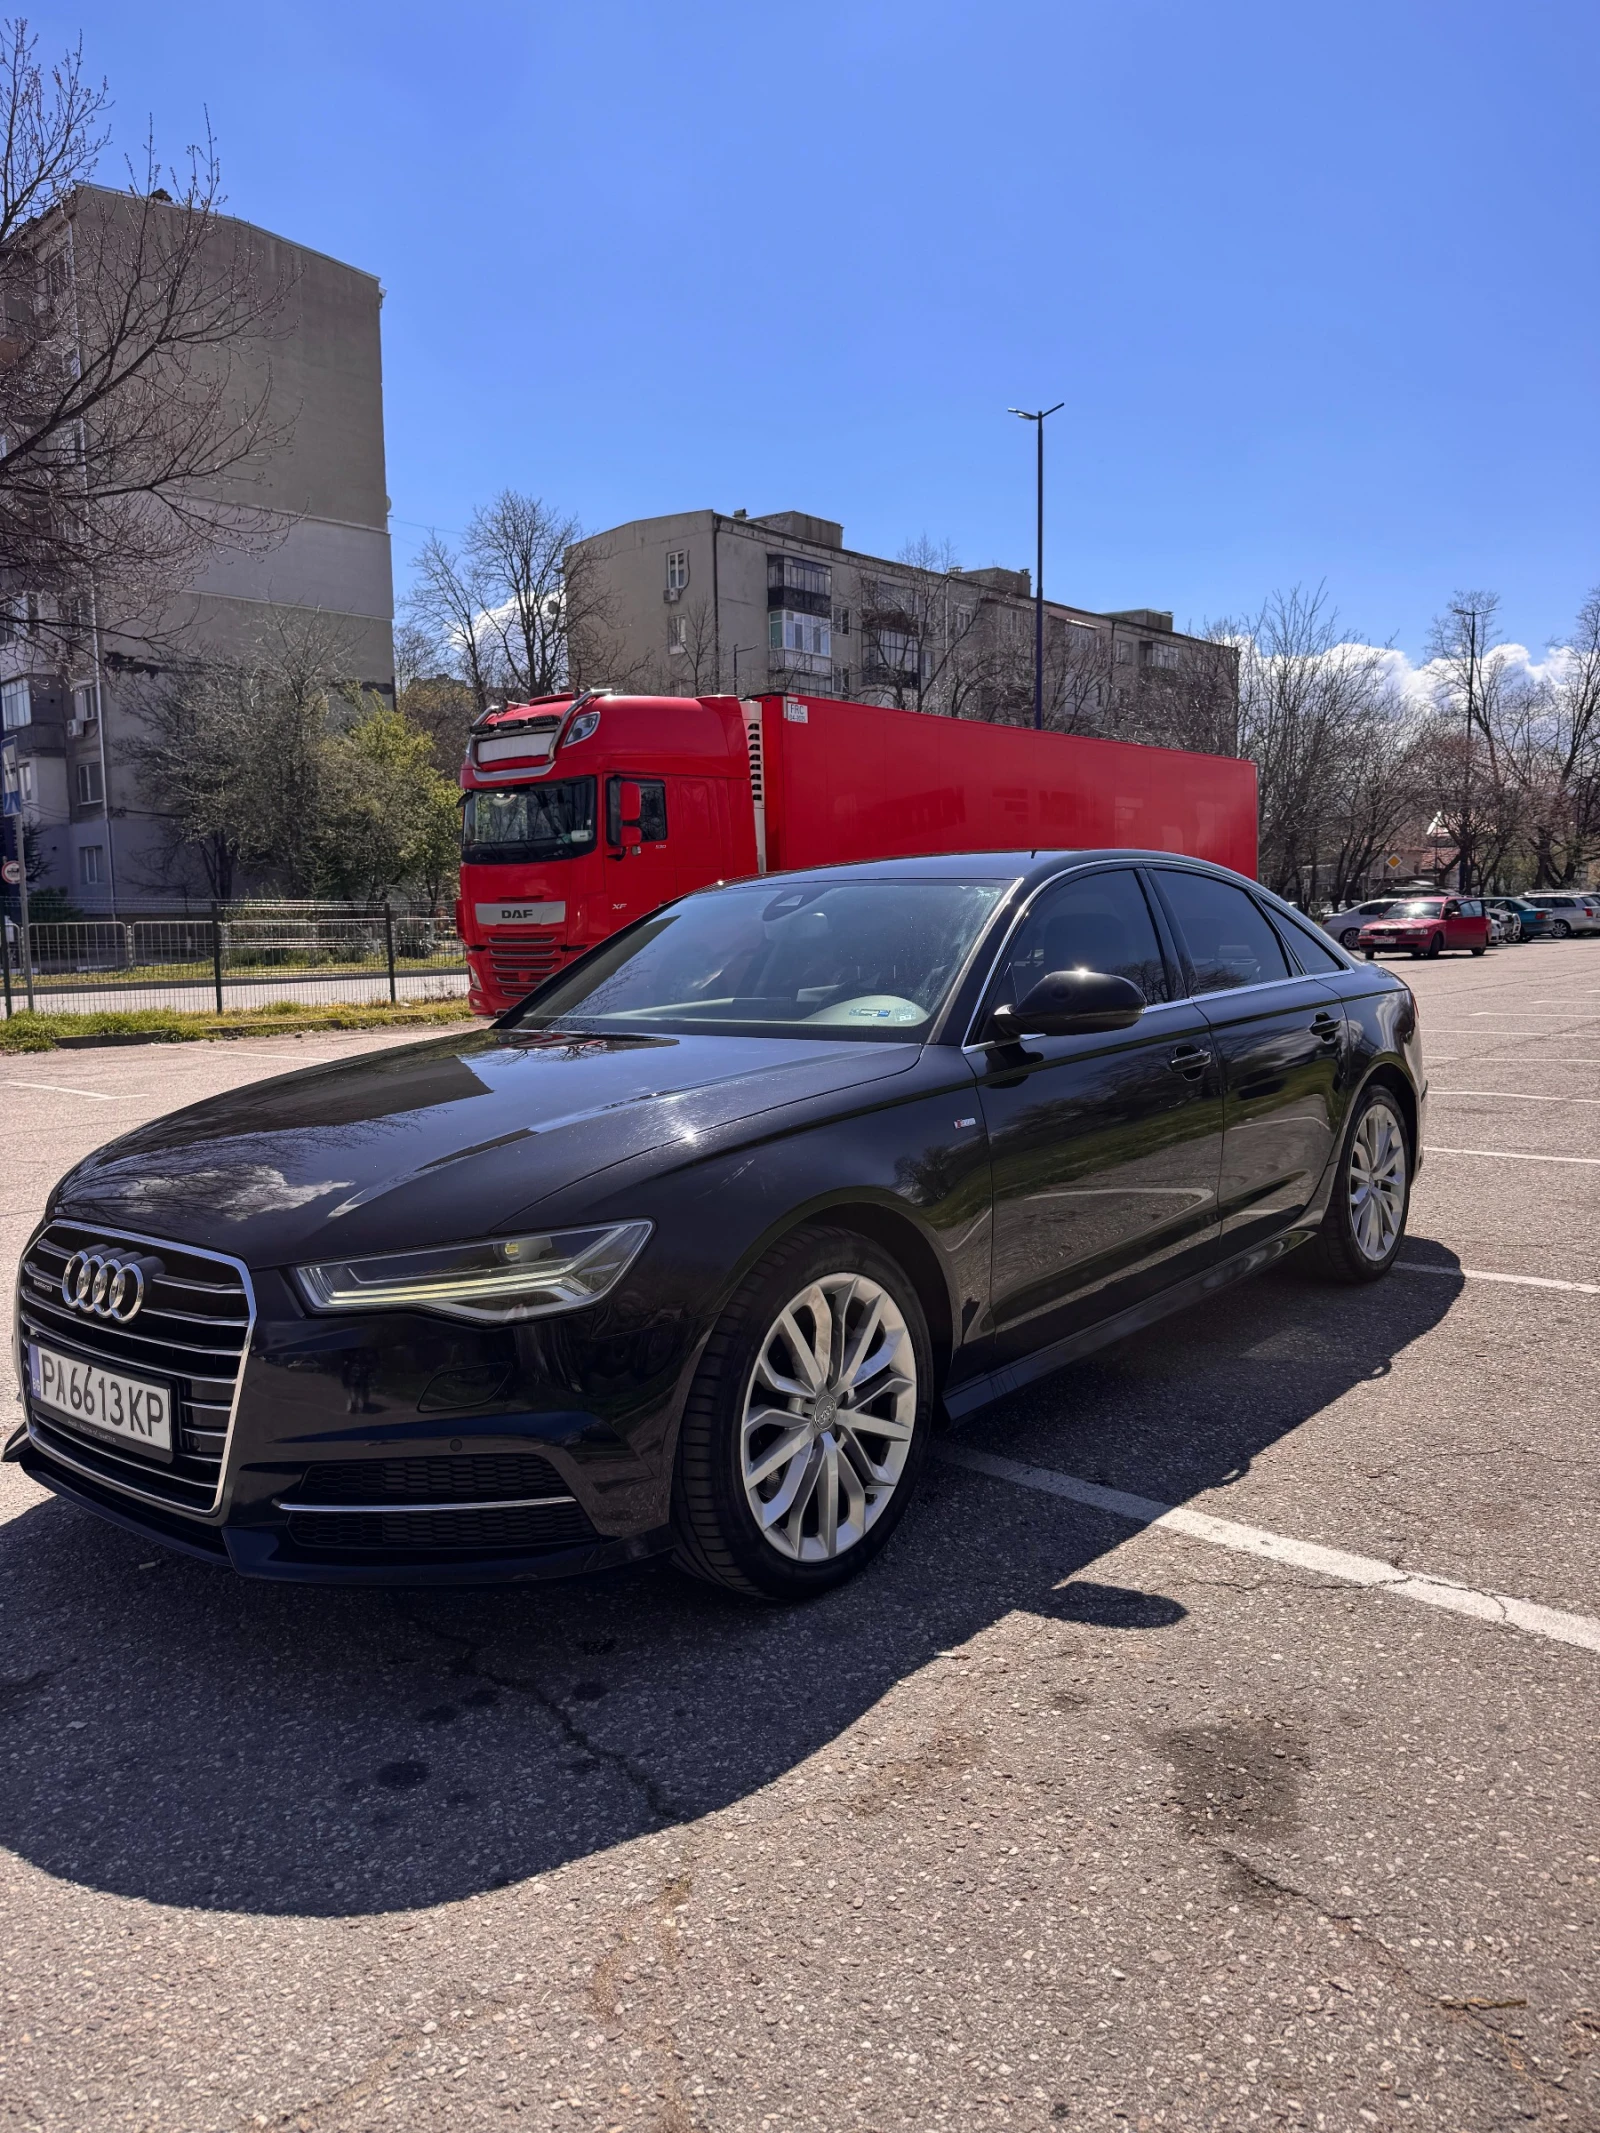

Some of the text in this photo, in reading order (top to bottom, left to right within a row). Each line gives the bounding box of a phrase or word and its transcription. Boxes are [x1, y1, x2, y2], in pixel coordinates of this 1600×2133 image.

[790, 704, 804, 715] FRC
[501, 909, 533, 919] DAF
[41, 1353, 164, 1437] PA6613KP
